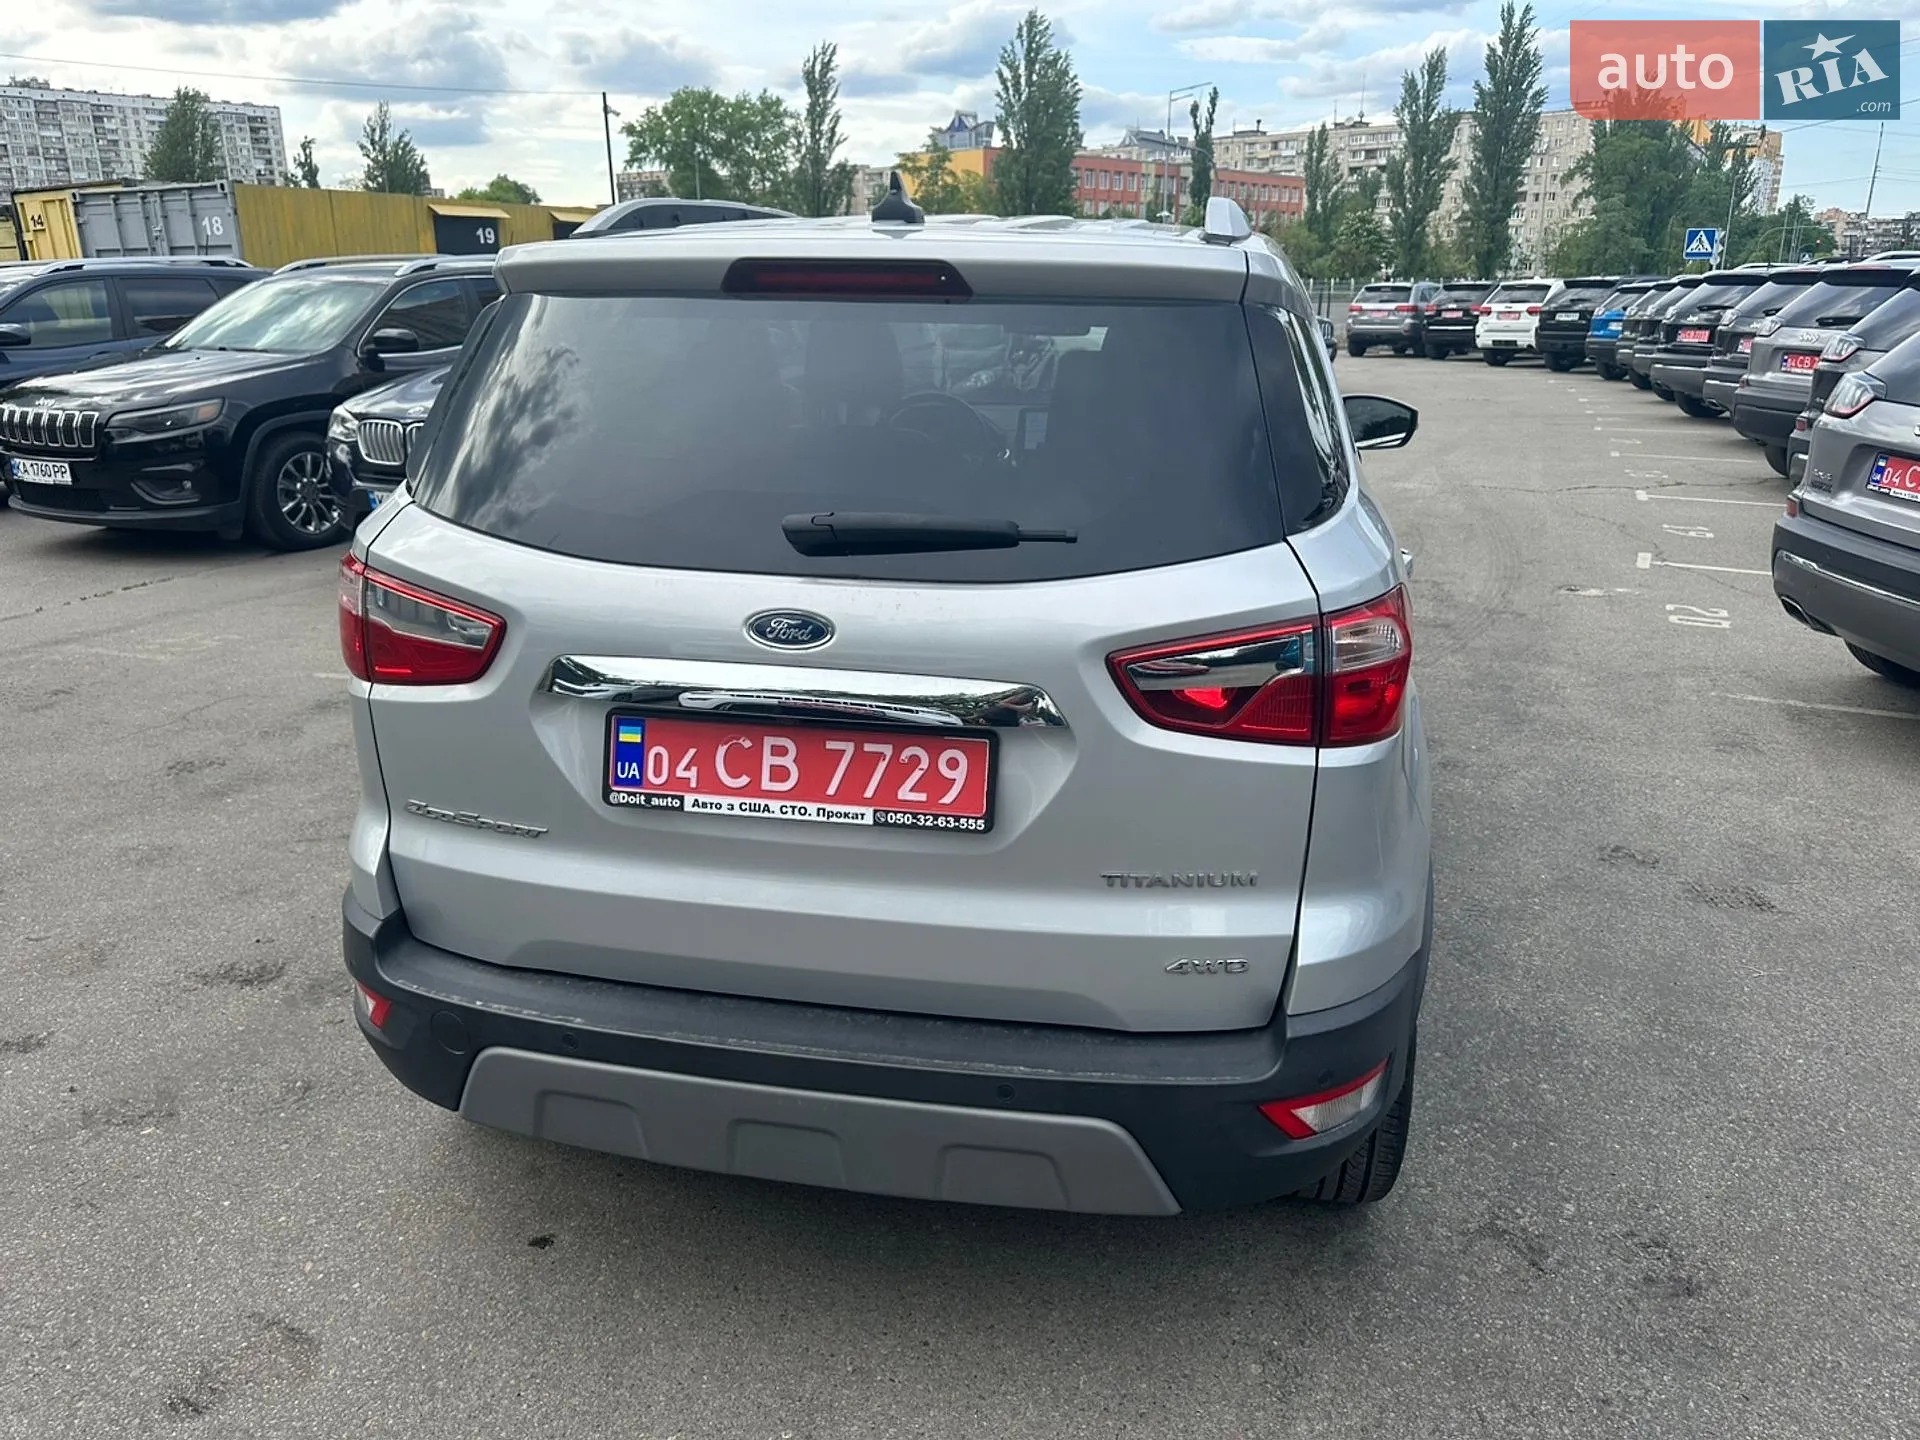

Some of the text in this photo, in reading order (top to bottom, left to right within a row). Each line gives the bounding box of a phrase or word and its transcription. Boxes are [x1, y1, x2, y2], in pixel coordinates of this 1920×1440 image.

[31, 214, 44, 227] 14
[202, 216, 224, 236] 18
[476, 227, 496, 244] 19
[1883, 467, 1901, 485] 04
[766, 617, 814, 640] Ford
[617, 761, 640, 779] UA
[647, 735, 968, 805] 04 CB 7729
[609, 792, 681, 807] @Doit_auto
[691, 798, 722, 811] Авто
[739, 802, 775, 814] США.
[780, 805, 812, 817] СТО.
[816, 807, 866, 822] Прокат
[887, 812, 985, 831] 050-32-63-555
[1101, 871, 1259, 888] TITANIUM
[1165, 957, 1249, 975] 4WD
